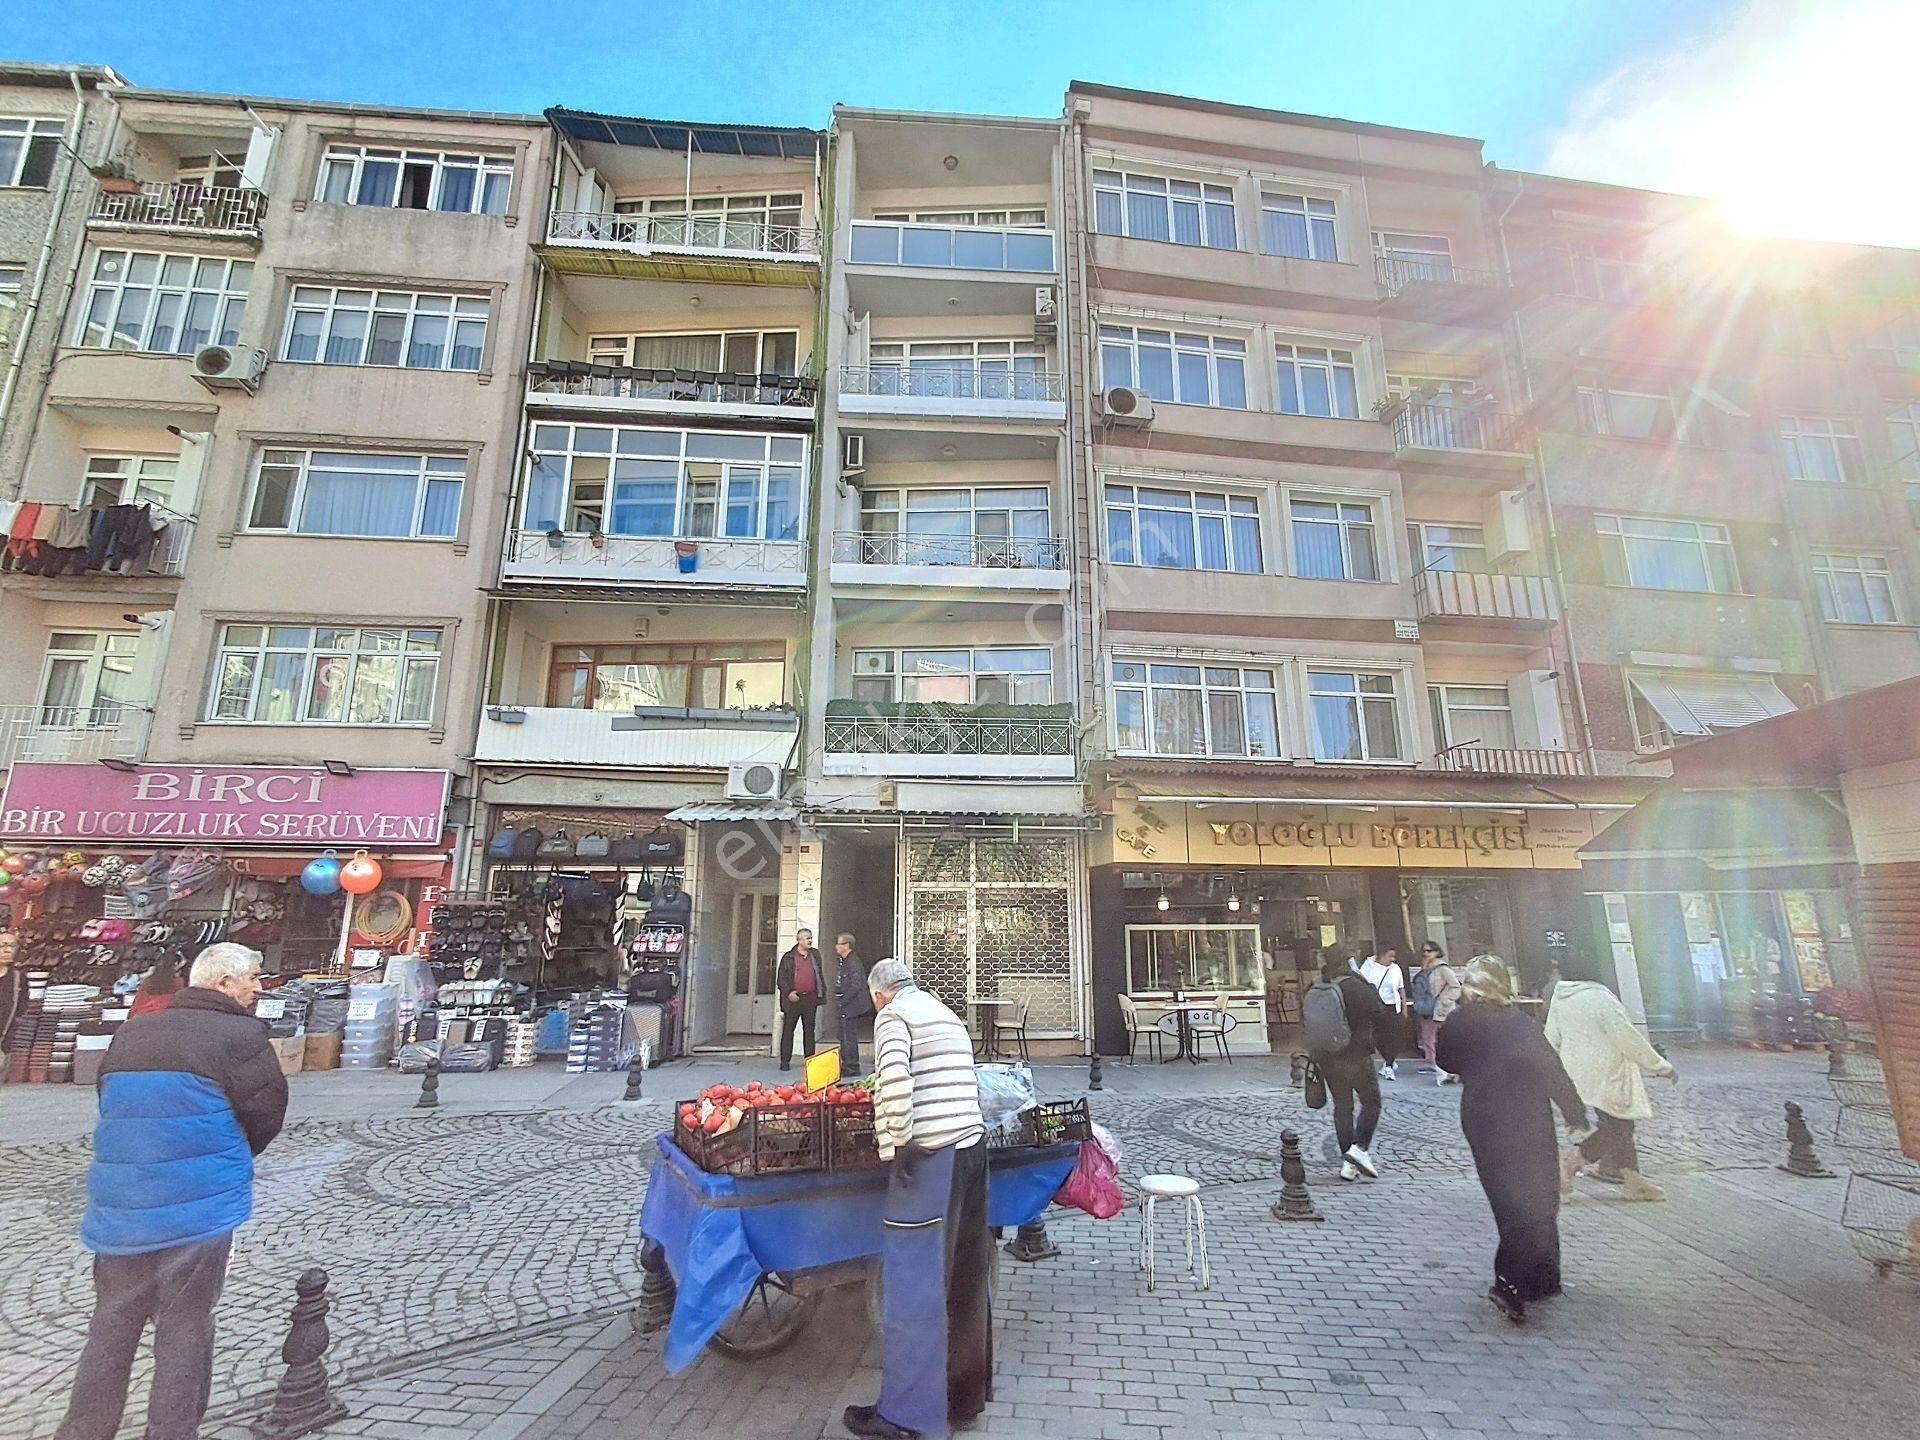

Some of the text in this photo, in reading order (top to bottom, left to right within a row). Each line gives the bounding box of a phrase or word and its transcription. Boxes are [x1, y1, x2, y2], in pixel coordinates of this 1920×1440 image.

[132, 769, 327, 805] BİRCİ
[1, 806, 437, 840] BİR UCUZLUK SERÜVENİ
[1209, 814, 1532, 856] YOLOĞLU BÖREKÇİSİ
